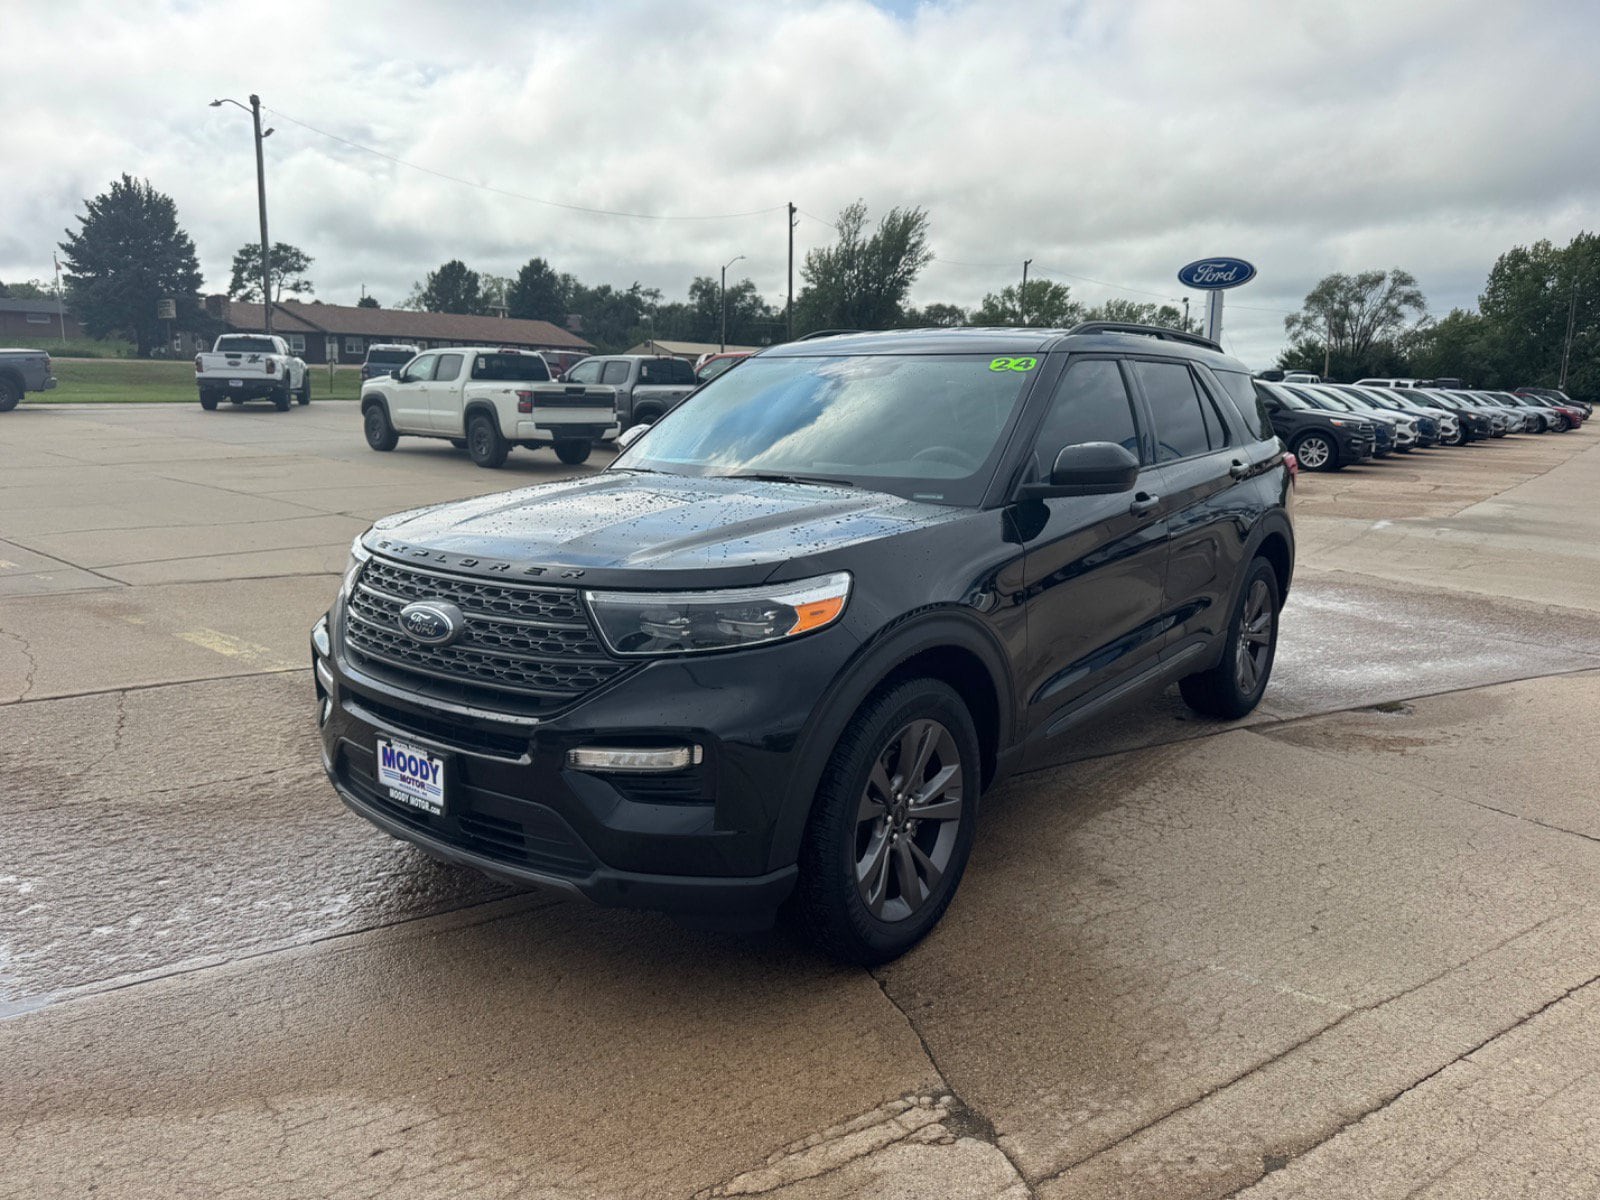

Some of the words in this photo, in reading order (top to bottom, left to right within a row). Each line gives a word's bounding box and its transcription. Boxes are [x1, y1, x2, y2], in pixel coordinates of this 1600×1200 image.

[1192, 262, 1238, 282] Ford
[992, 358, 1034, 370] 24
[377, 540, 585, 580] EXPLORER
[407, 612, 438, 635] Ford
[382, 746, 440, 785] MOODY
[399, 773, 426, 791] MOTOR
[389, 788, 410, 804] MOODY
